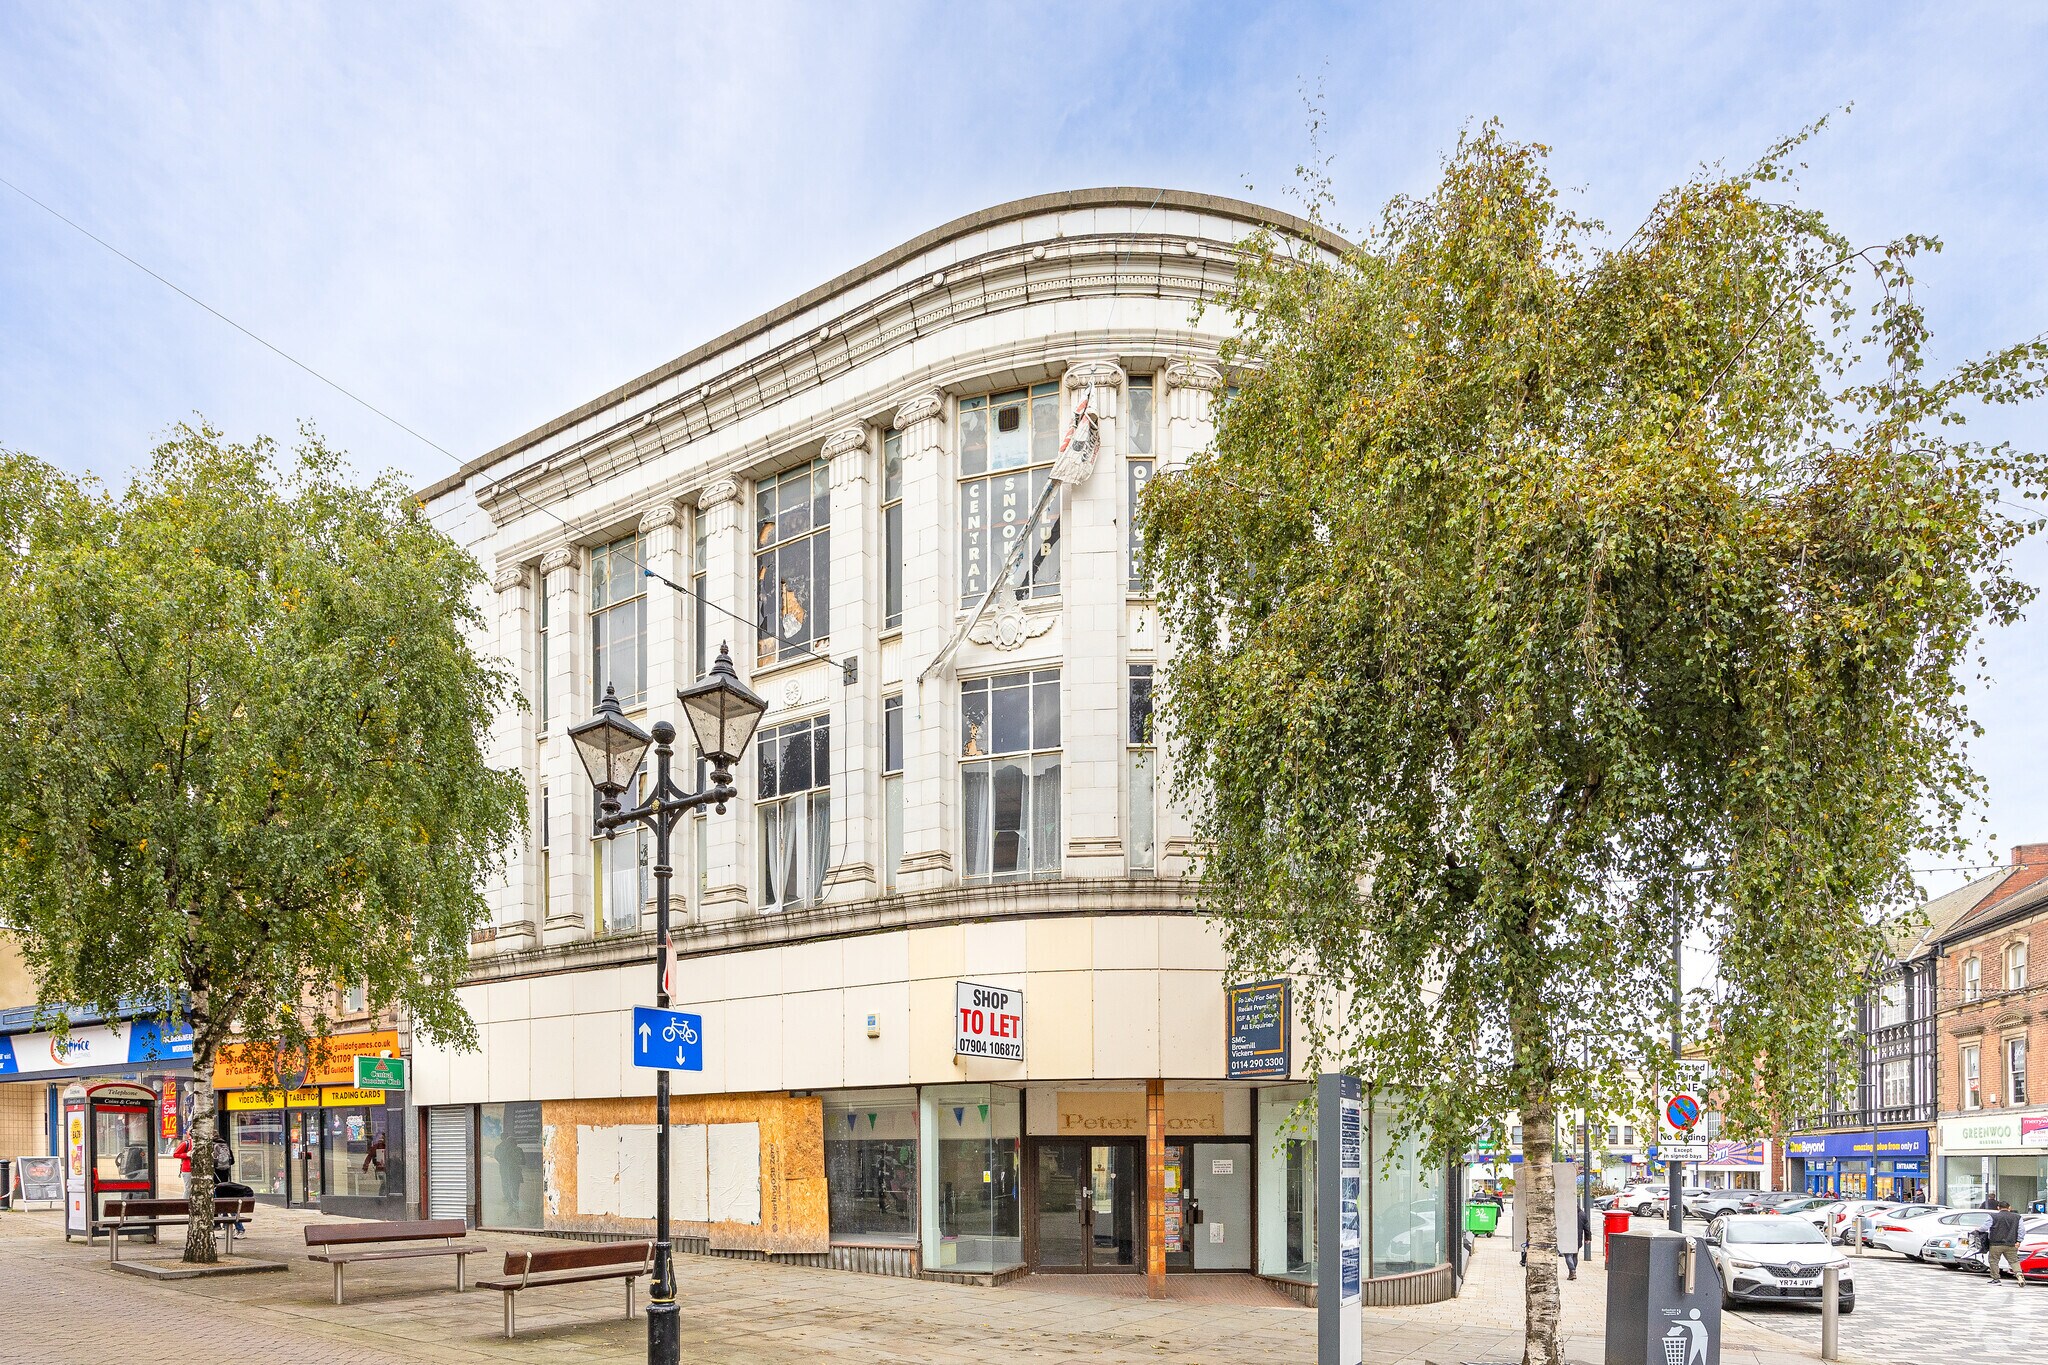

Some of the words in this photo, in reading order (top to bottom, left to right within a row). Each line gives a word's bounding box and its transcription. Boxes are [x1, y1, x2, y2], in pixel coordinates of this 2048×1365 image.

[1040, 497, 1052, 557] LUB
[967, 484, 981, 592] CENTRAL
[973, 988, 1009, 1010] SHOP
[960, 1007, 984, 1035] TO
[989, 1012, 1021, 1039] LET
[1249, 1021, 1274, 1030] Enquiries
[1231, 1036, 1247, 1044] SMC
[959, 1038, 987, 1054] 07904
[989, 1041, 1020, 1057] 106872
[331, 1054, 351, 1063] 01709
[1231, 1060, 1248, 1069] 0114
[1249, 1058, 1264, 1068] 290
[1264, 1057, 1284, 1067] 3300
[371, 1071, 393, 1079] Central
[108, 1089, 139, 1097] Telephone
[289, 1093, 306, 1101] TABLE
[307, 1092, 320, 1100] TOP
[332, 1091, 359, 1100] TRADING
[360, 1089, 381, 1099] CARDS
[238, 1096, 254, 1104] VIDEO
[163, 1116, 177, 1129] 1/2
[1061, 1112, 1138, 1130] Peter
[1164, 1113, 1217, 1130] ord
[1660, 1133, 1673, 1141] No
[1962, 1125, 2011, 1140] GREENWOO
[1673, 1147, 1693, 1155] Except
[1888, 1142, 1901, 1151] from
[1900, 1142, 1914, 1152] only
[1913, 1142, 1919, 1150] £1
[1896, 1162, 1918, 1170] ENTRANCE
